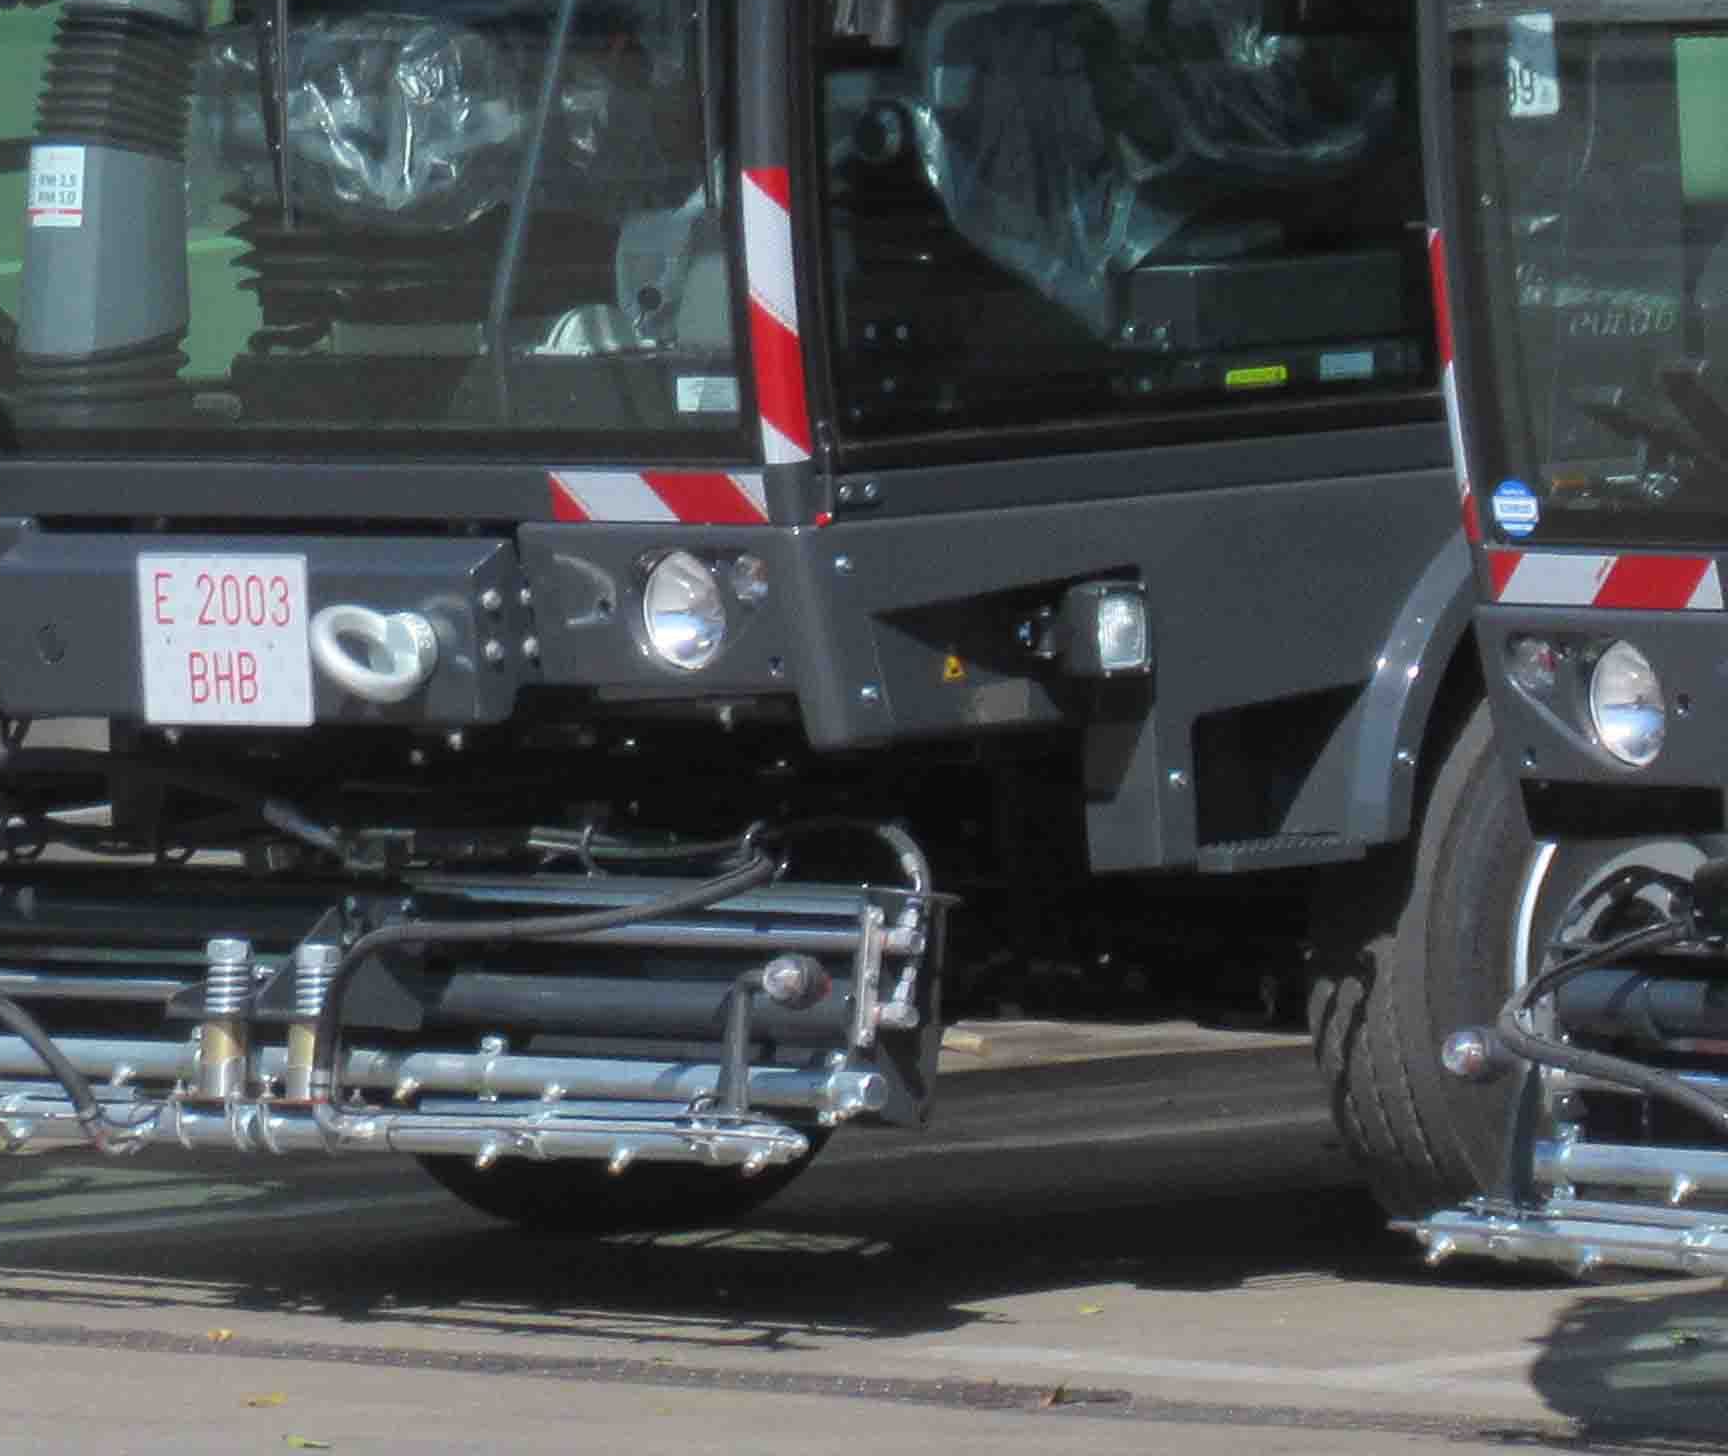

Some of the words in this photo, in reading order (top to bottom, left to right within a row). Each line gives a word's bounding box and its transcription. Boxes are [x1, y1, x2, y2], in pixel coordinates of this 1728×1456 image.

[153, 572, 175, 624] E
[196, 573, 291, 627] 2003
[188, 651, 259, 704] BHB
